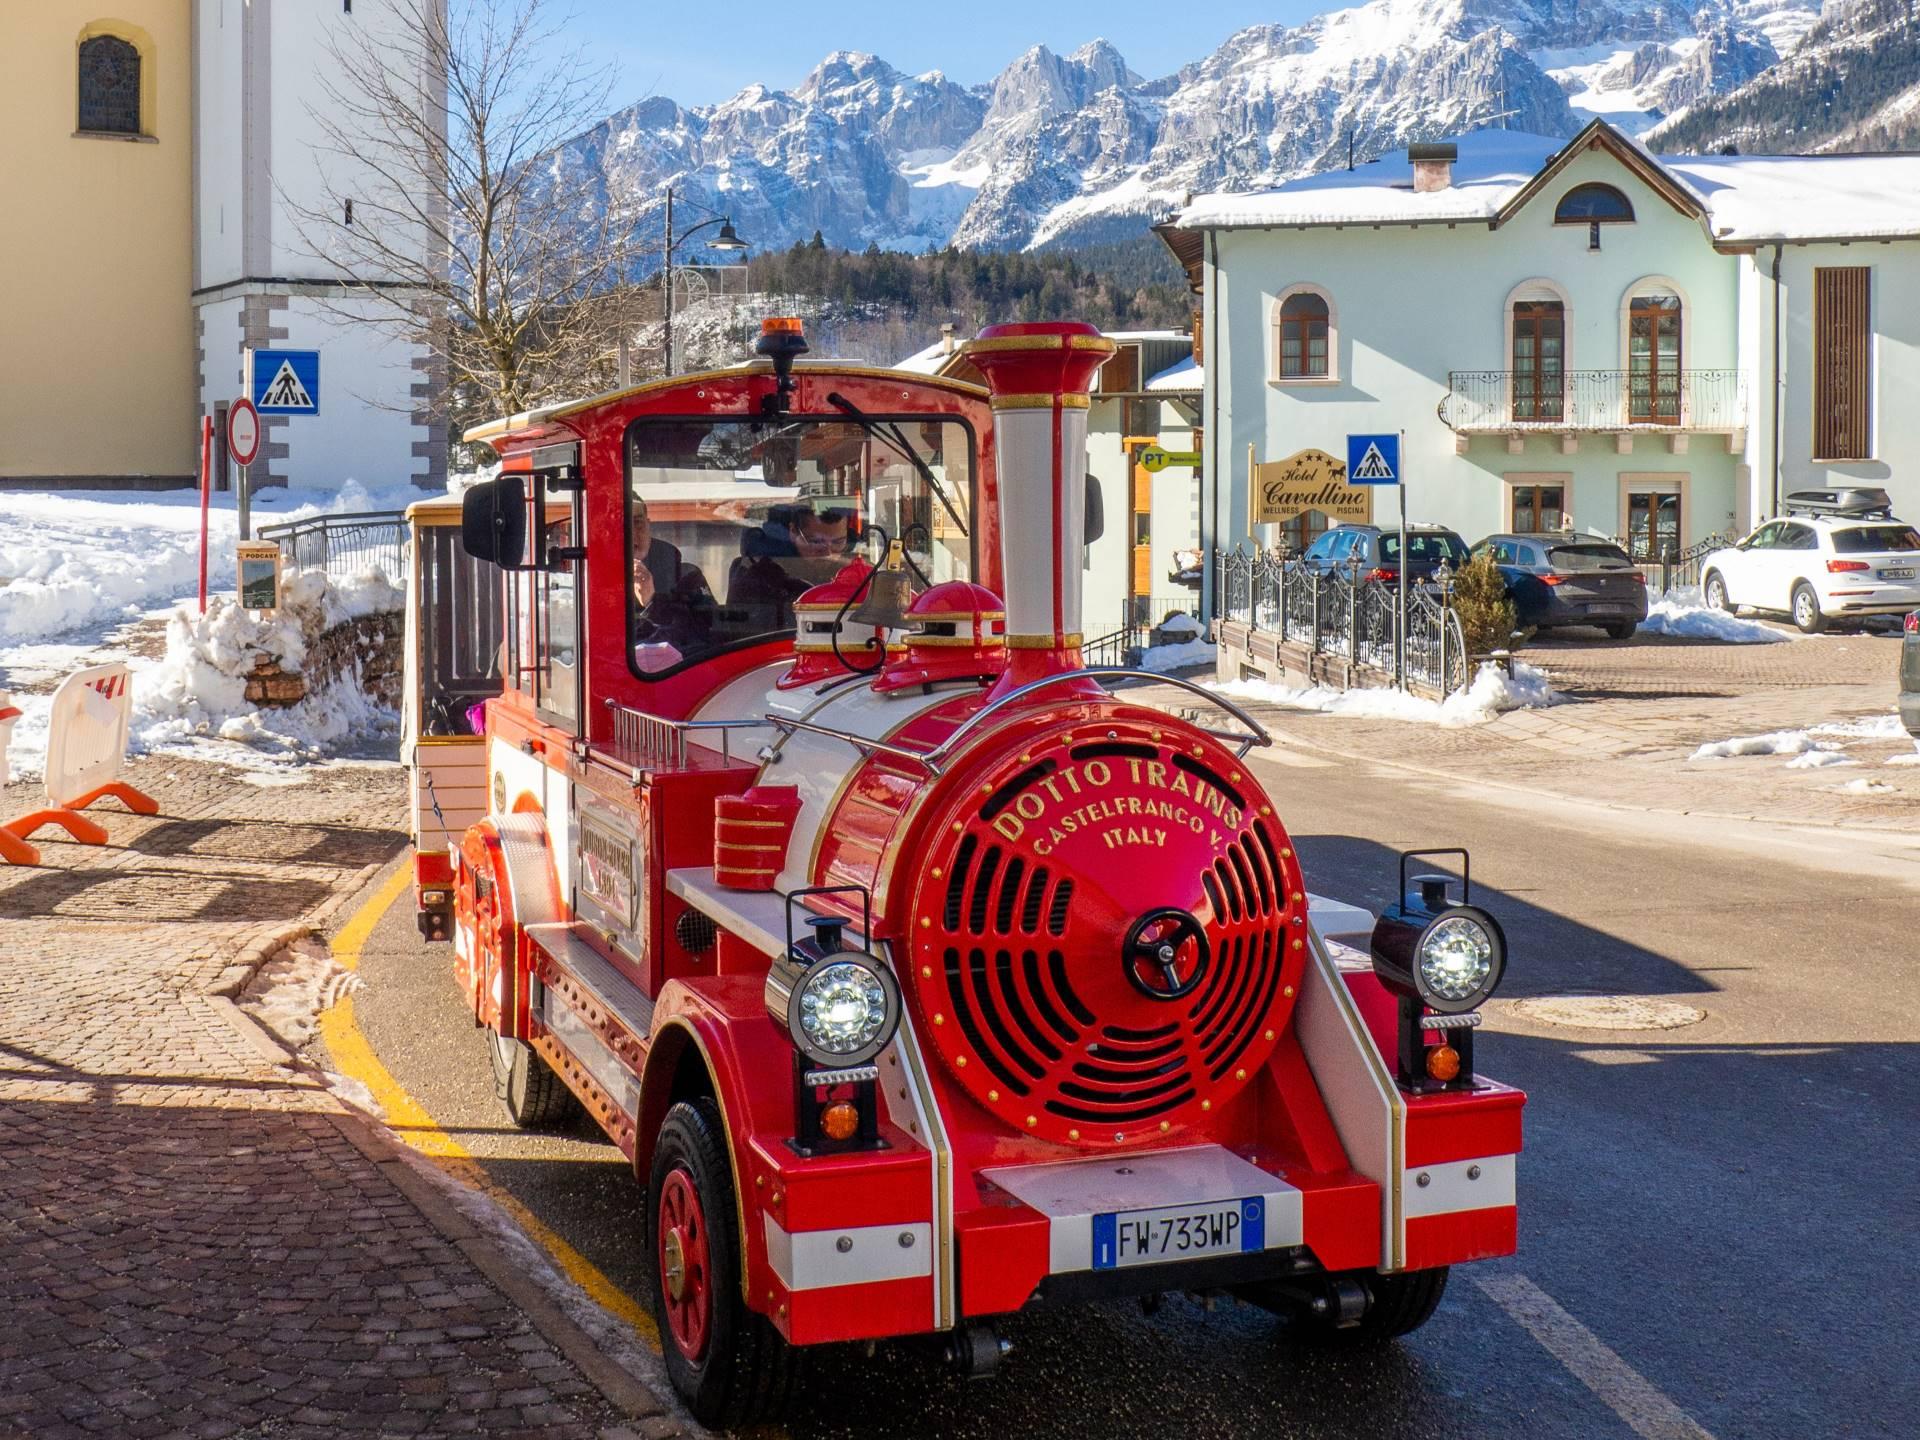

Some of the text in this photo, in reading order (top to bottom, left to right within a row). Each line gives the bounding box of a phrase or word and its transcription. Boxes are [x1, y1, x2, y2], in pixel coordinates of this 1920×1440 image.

[1145, 453, 1164, 465] PT
[1281, 468, 1318, 482] Hotel
[1263, 481, 1365, 505] Cavallino
[1263, 506, 1364, 514] WELLNESS PISCINA
[992, 757, 1242, 842] DOTTO TRAINS
[1033, 797, 1223, 855] CASTELFRANCO V.
[1103, 826, 1167, 849] ITALY
